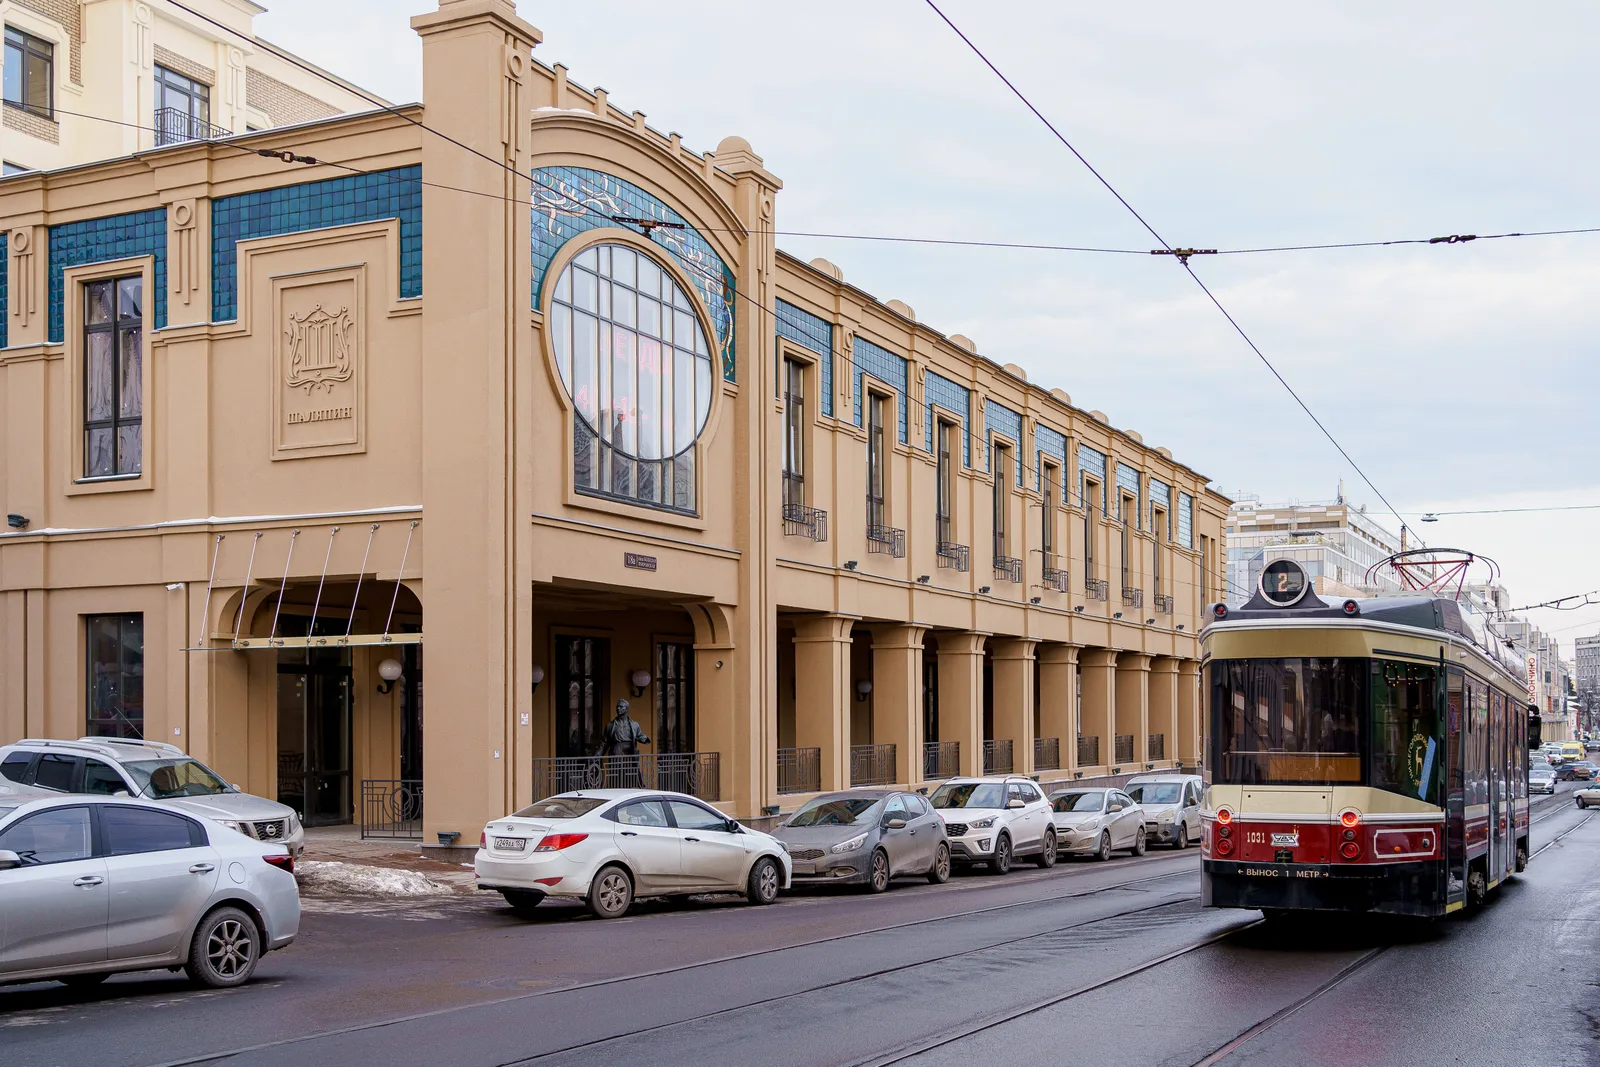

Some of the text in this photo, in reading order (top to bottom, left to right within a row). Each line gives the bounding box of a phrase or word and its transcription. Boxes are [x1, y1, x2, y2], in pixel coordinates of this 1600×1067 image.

[287, 407, 352, 425] ШАЛЯПИН
[1278, 572, 1288, 592] 2
[1246, 831, 1266, 844] 1031
[1246, 868, 1320, 878] ВЫНОС 1 МЕТР
